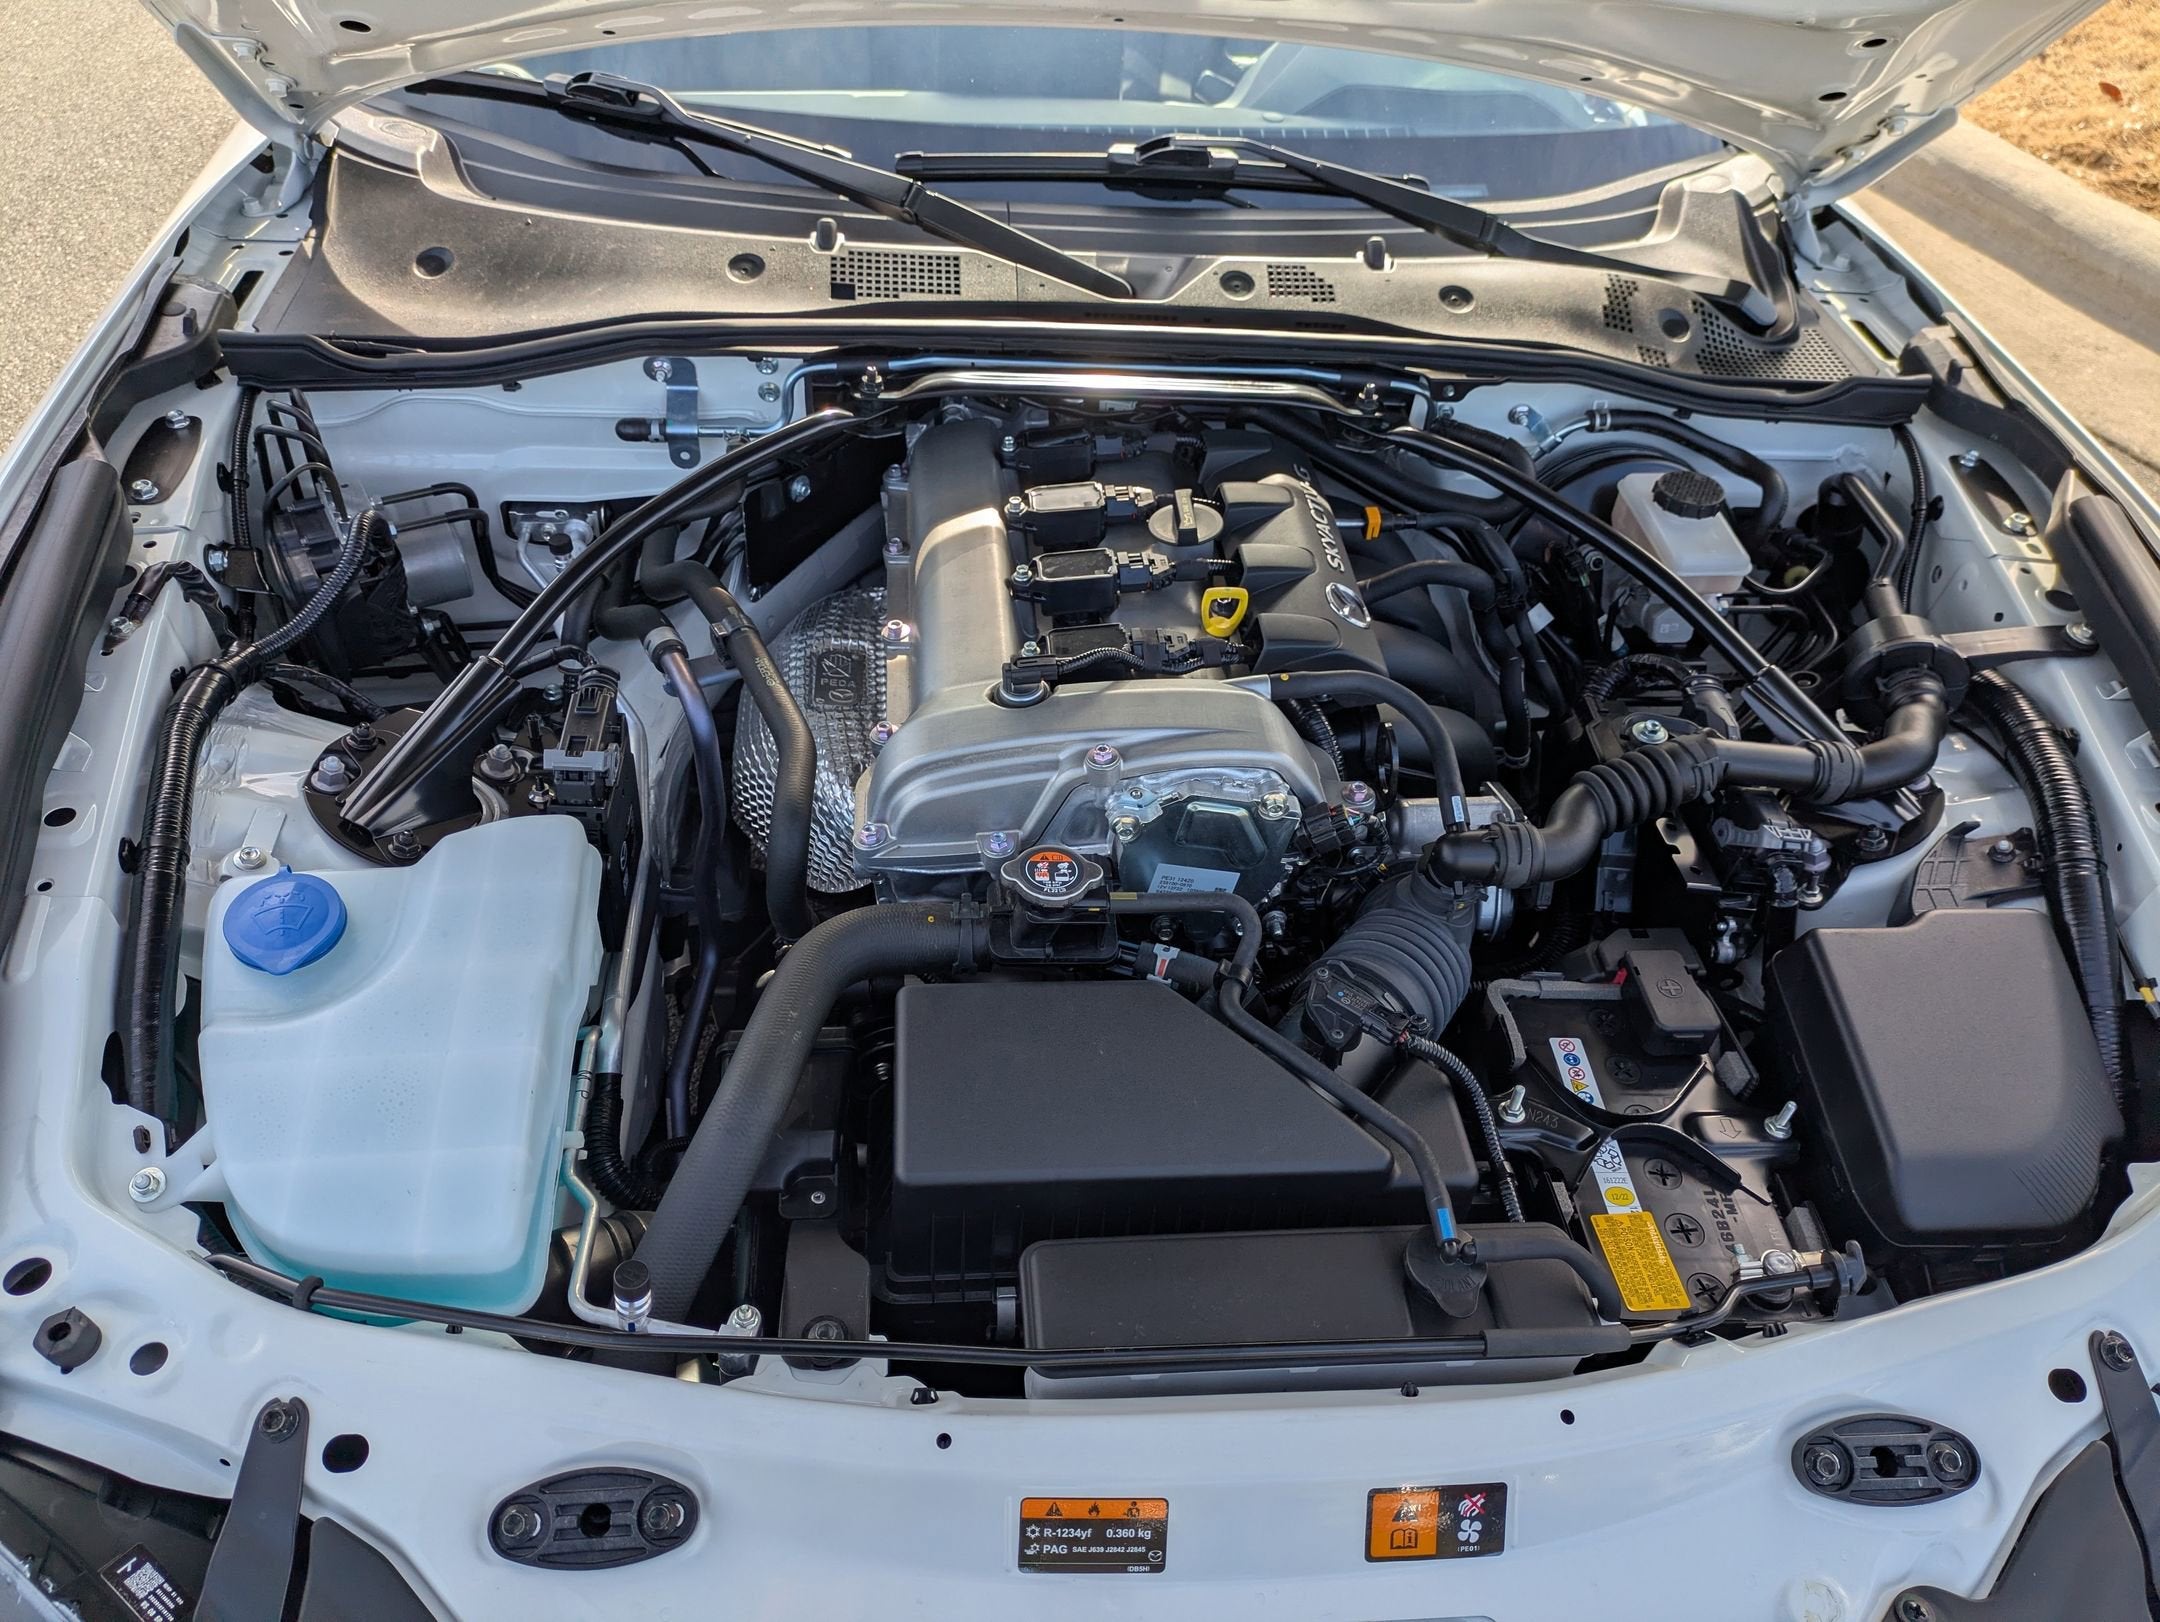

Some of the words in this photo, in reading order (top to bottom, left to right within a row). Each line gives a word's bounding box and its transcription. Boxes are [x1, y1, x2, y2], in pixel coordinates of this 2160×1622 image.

[1293, 463, 1345, 573] SKYACTIV-G
[1619, 1226, 1634, 1251] POISON
[1043, 1527, 1092, 1539] R-1234yf
[1106, 1528, 1134, 1538] 0.360
[1137, 1528, 1151, 1539] kg
[1042, 1544, 1067, 1554] PAG
